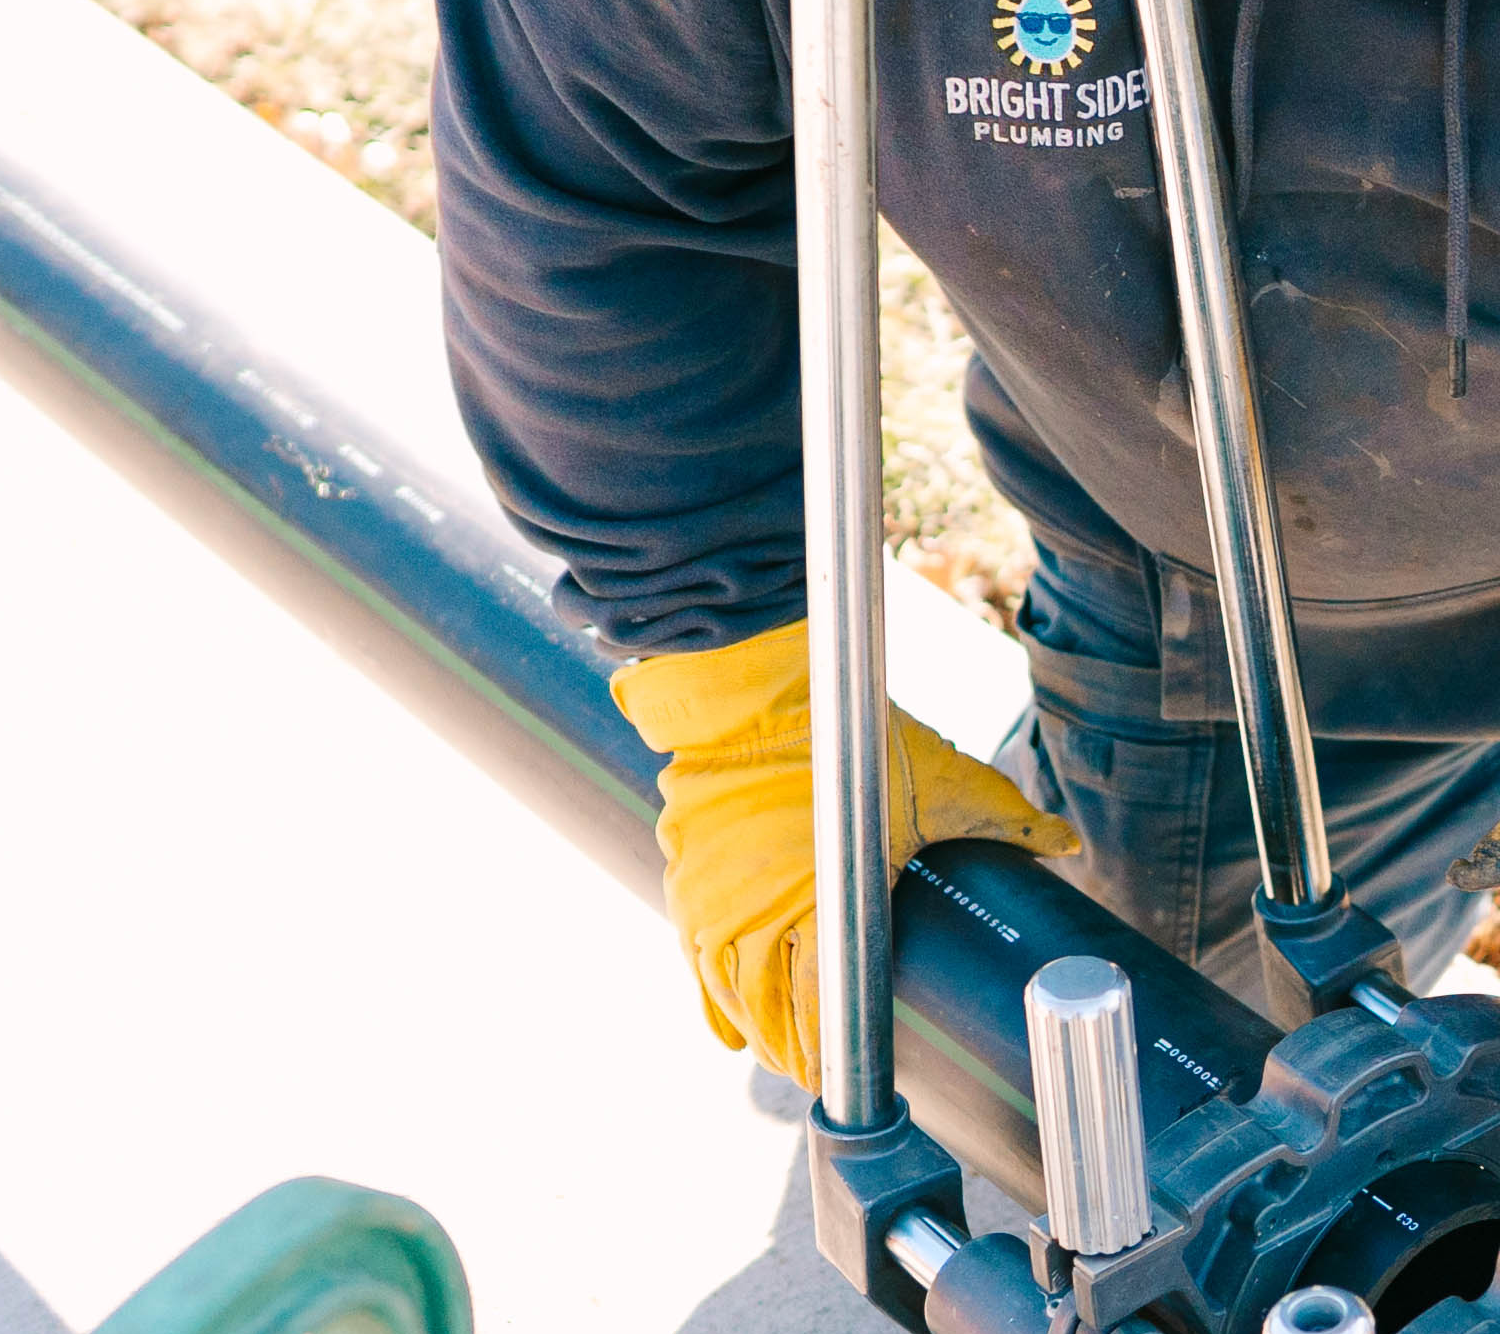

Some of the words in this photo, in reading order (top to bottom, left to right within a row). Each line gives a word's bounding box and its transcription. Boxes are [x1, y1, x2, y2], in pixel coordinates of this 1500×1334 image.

[945, 76, 1071, 121] BRIGHT
[1076, 69, 1144, 119] SIDE
[974, 121, 1124, 147] PLUMBING
